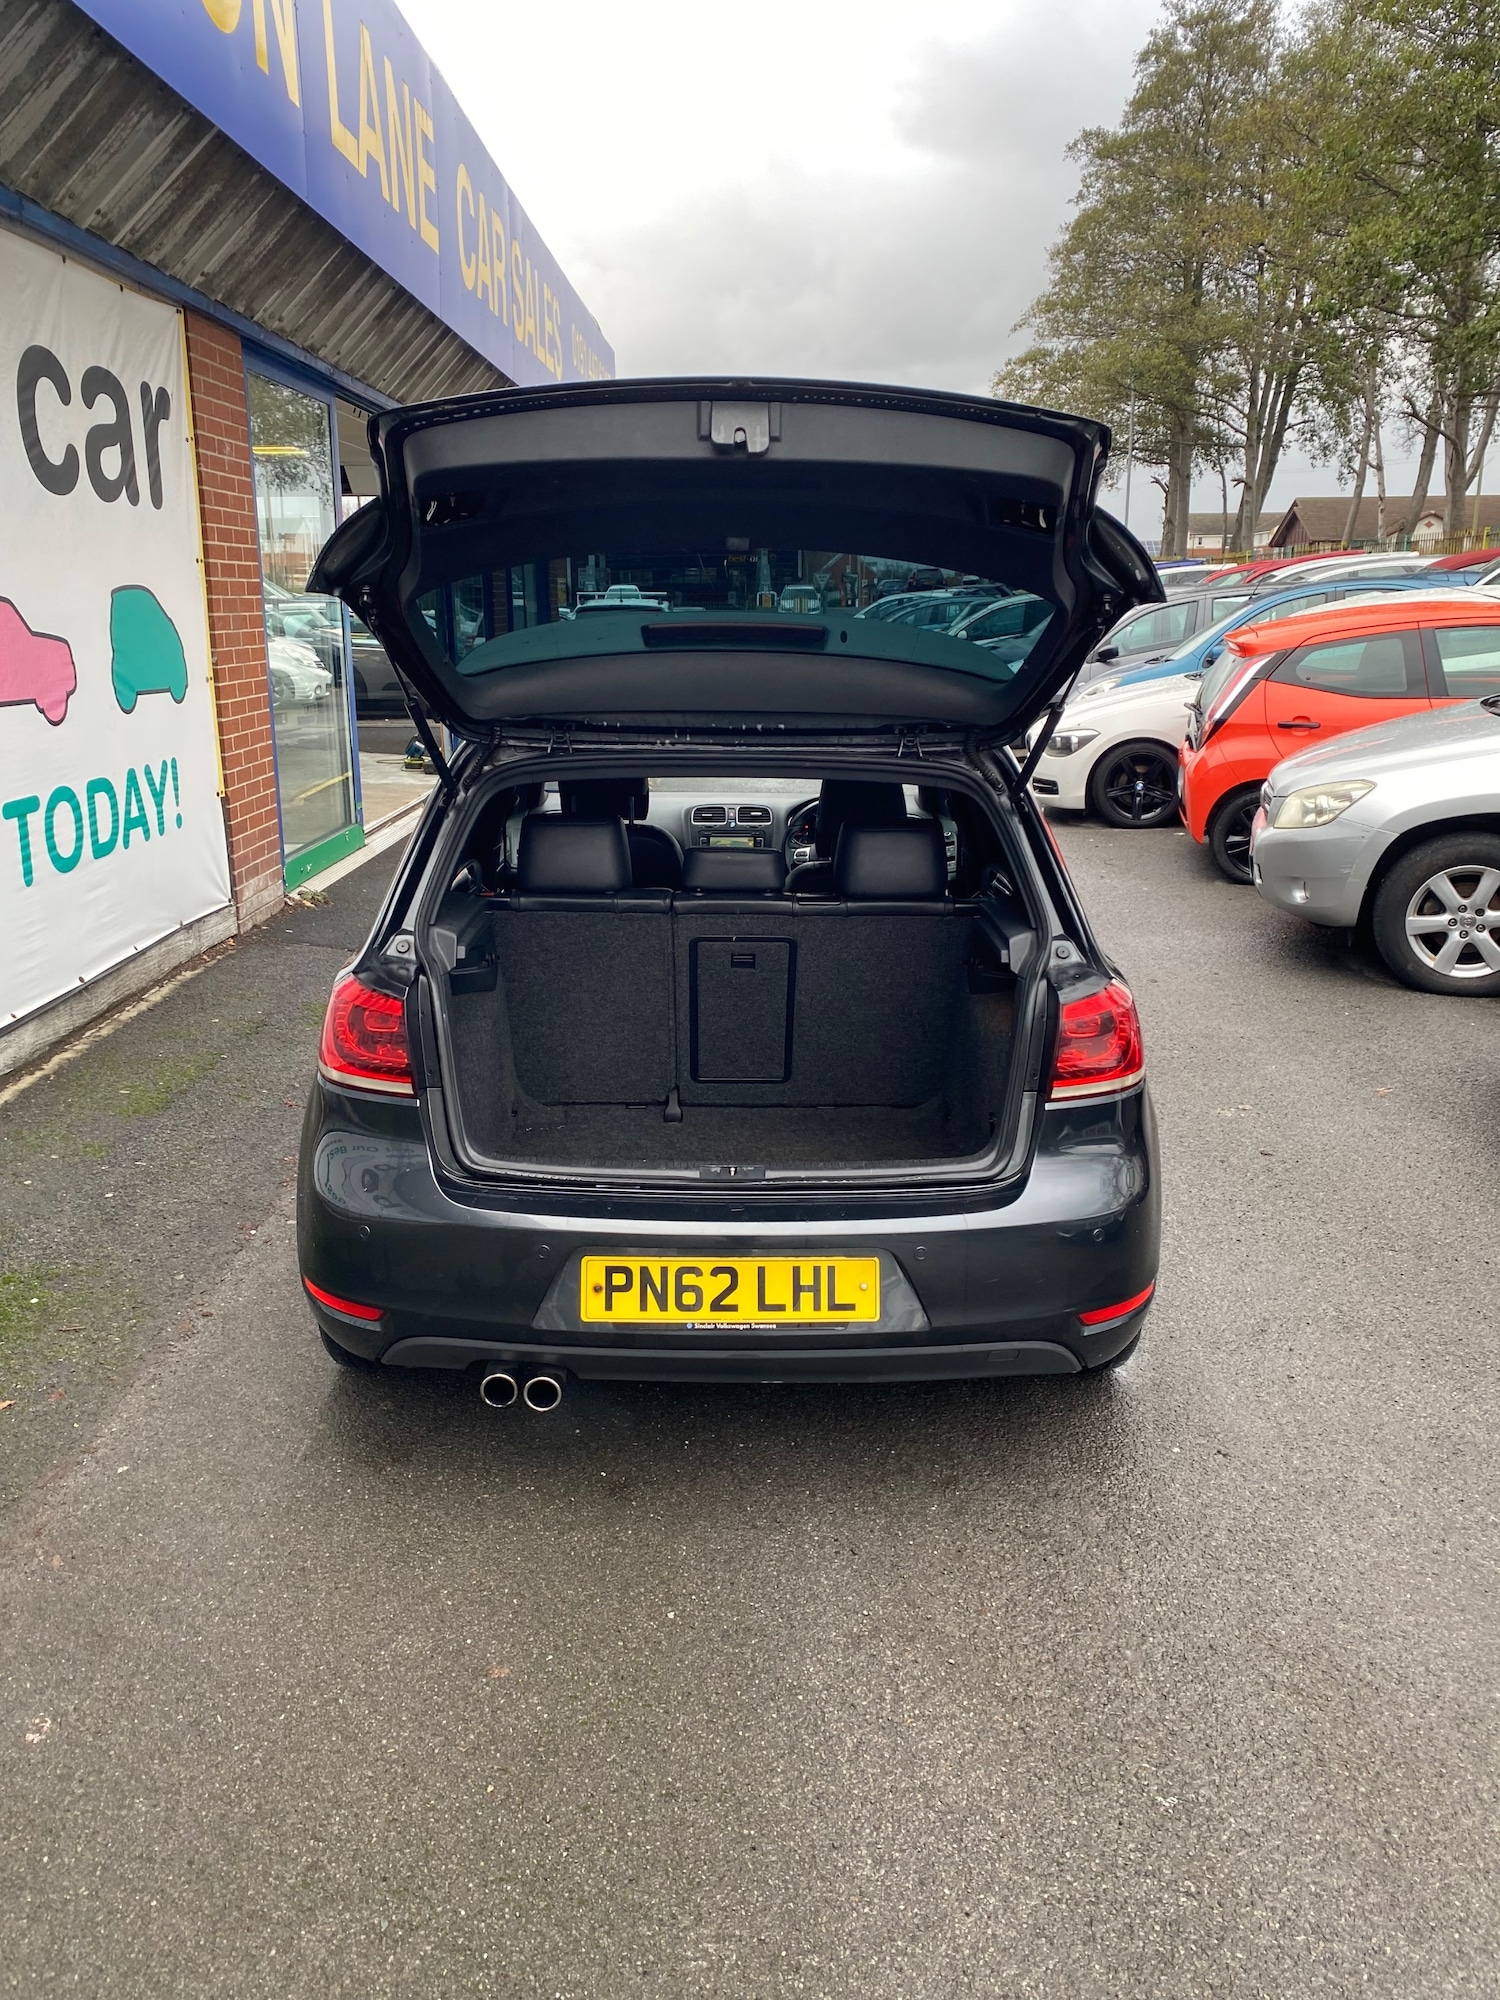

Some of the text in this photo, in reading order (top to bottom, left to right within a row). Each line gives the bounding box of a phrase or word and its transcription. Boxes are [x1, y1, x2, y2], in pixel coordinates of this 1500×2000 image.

[323, 0, 439, 255] LANE
[456, 163, 508, 327] CAR
[510, 237, 563, 381] SALES
[17, 344, 171, 510] car
[2, 757, 183, 887] TODAY!
[604, 1265, 857, 1313] PN62 LHL
[694, 1322, 777, 1331] Sinclair Volkswagen Swansea
